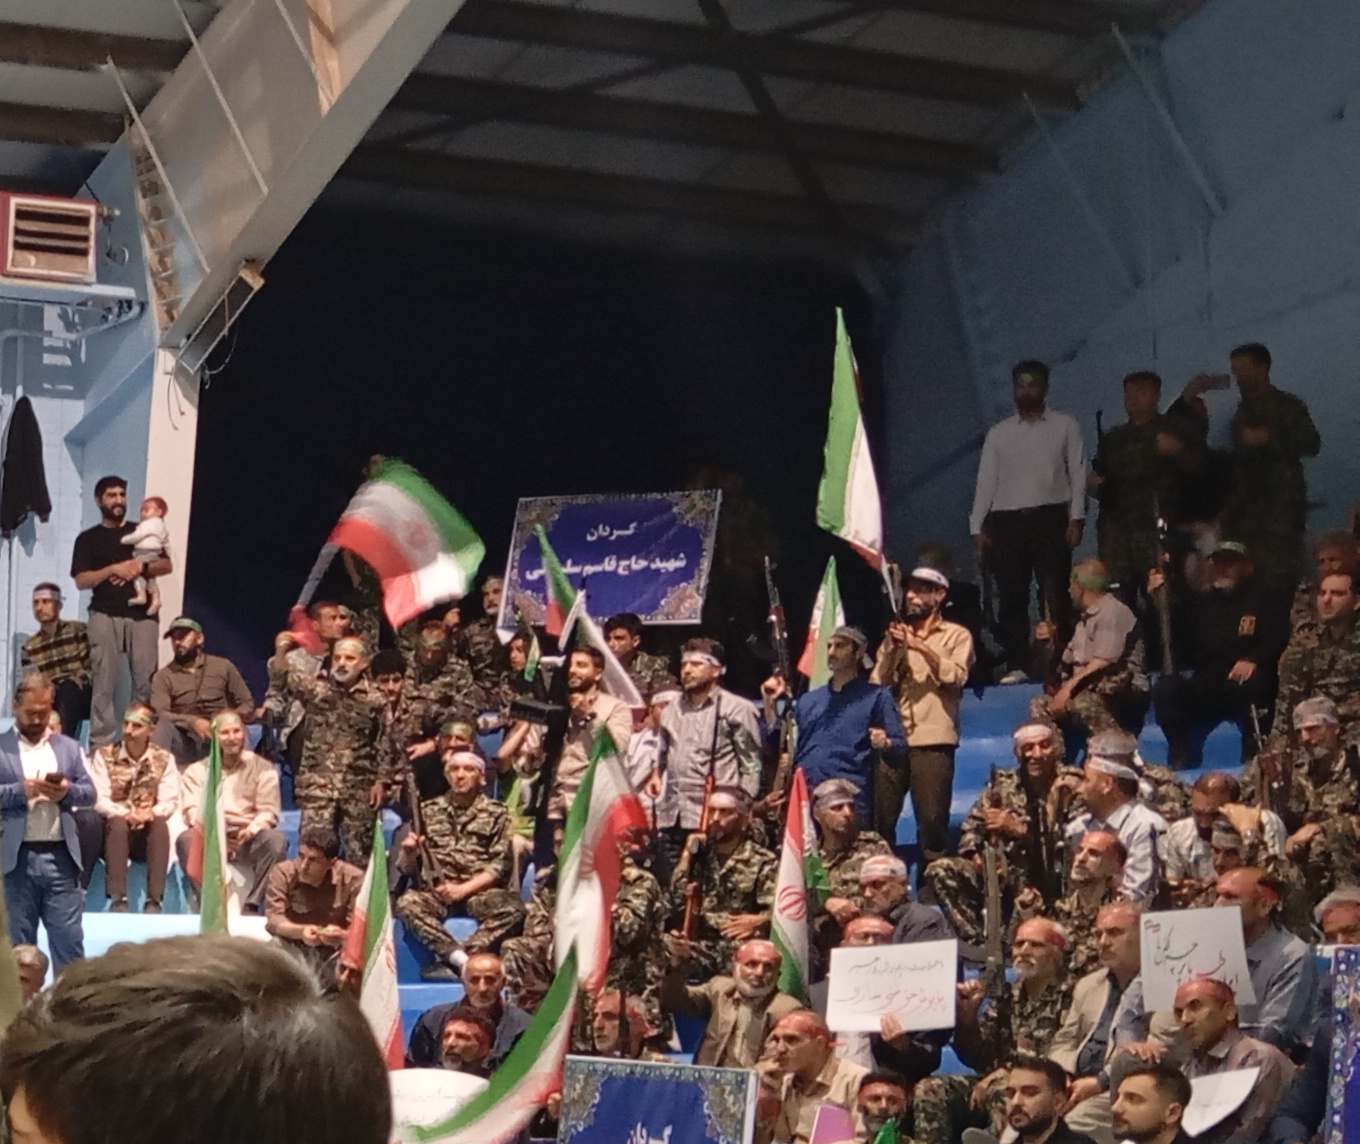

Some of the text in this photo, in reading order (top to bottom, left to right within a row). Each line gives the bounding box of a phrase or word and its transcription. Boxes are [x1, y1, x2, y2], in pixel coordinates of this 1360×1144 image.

[587, 523, 637, 541] گردان
[582, 555, 617, 577] قاسم
[617, 556, 649, 575] حاج
[650, 552, 688, 573] شهید
